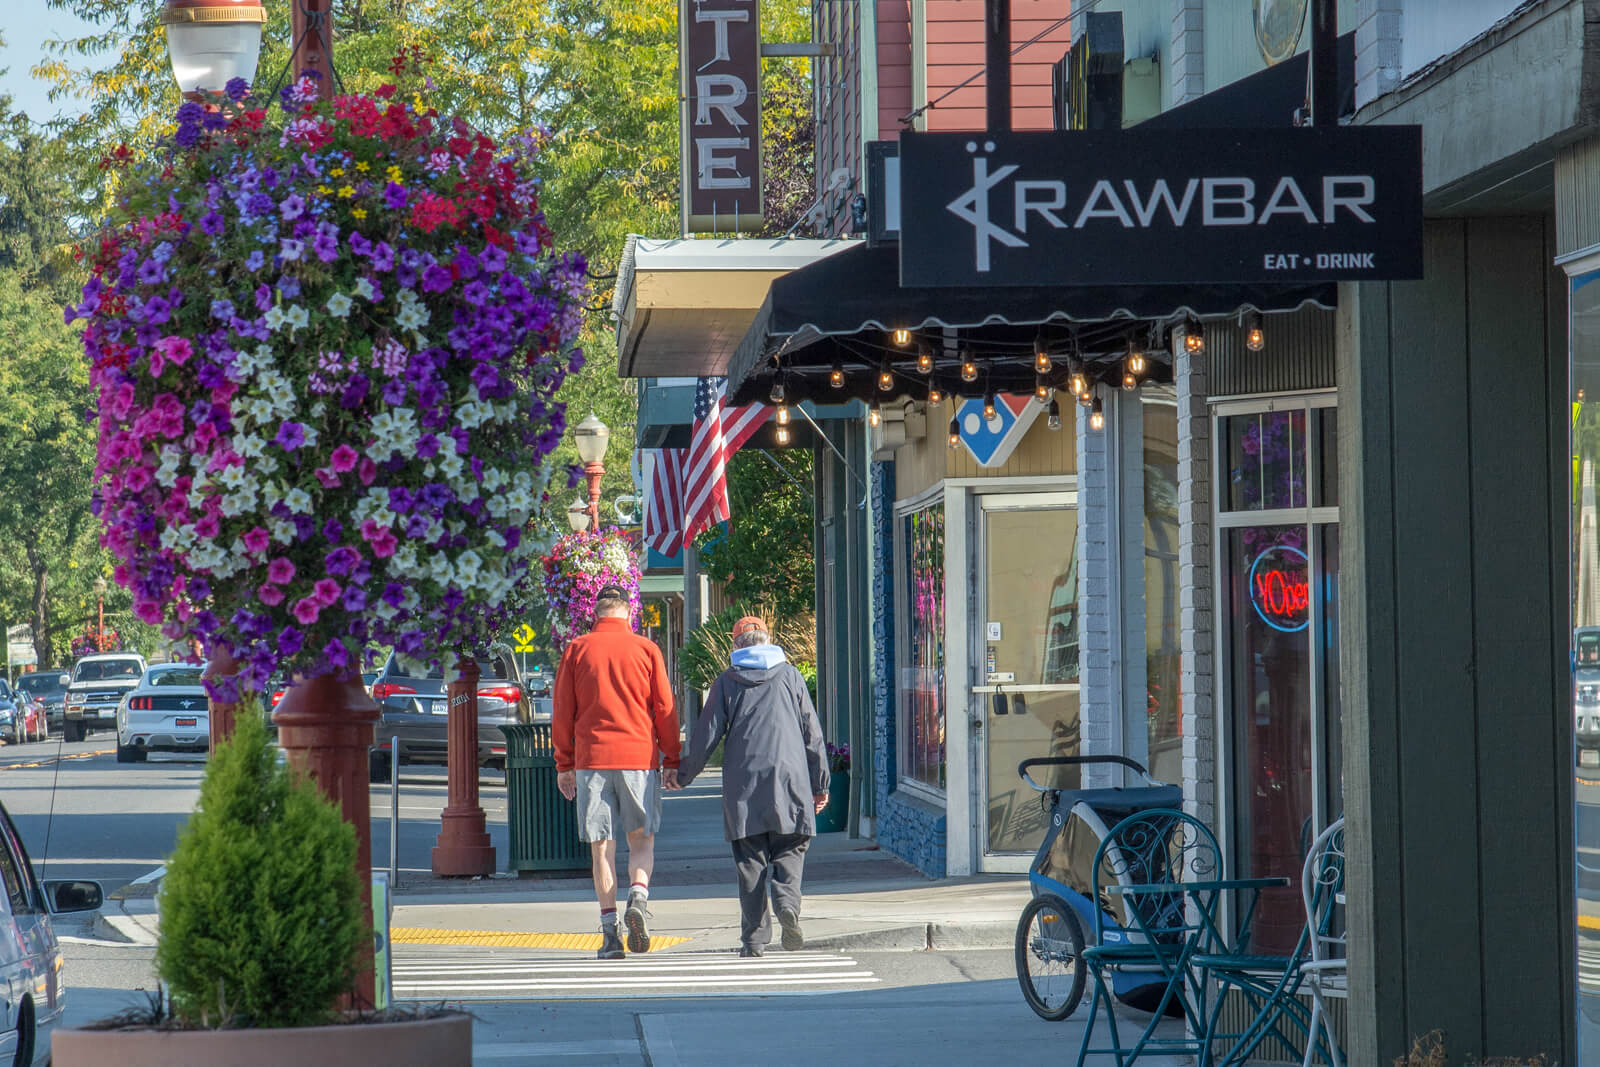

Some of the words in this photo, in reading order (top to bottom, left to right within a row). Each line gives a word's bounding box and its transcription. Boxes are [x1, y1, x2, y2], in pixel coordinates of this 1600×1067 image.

[694, 0, 751, 190] TRE
[1264, 254, 1299, 269] EAT
[1316, 253, 1375, 269] DRINK
